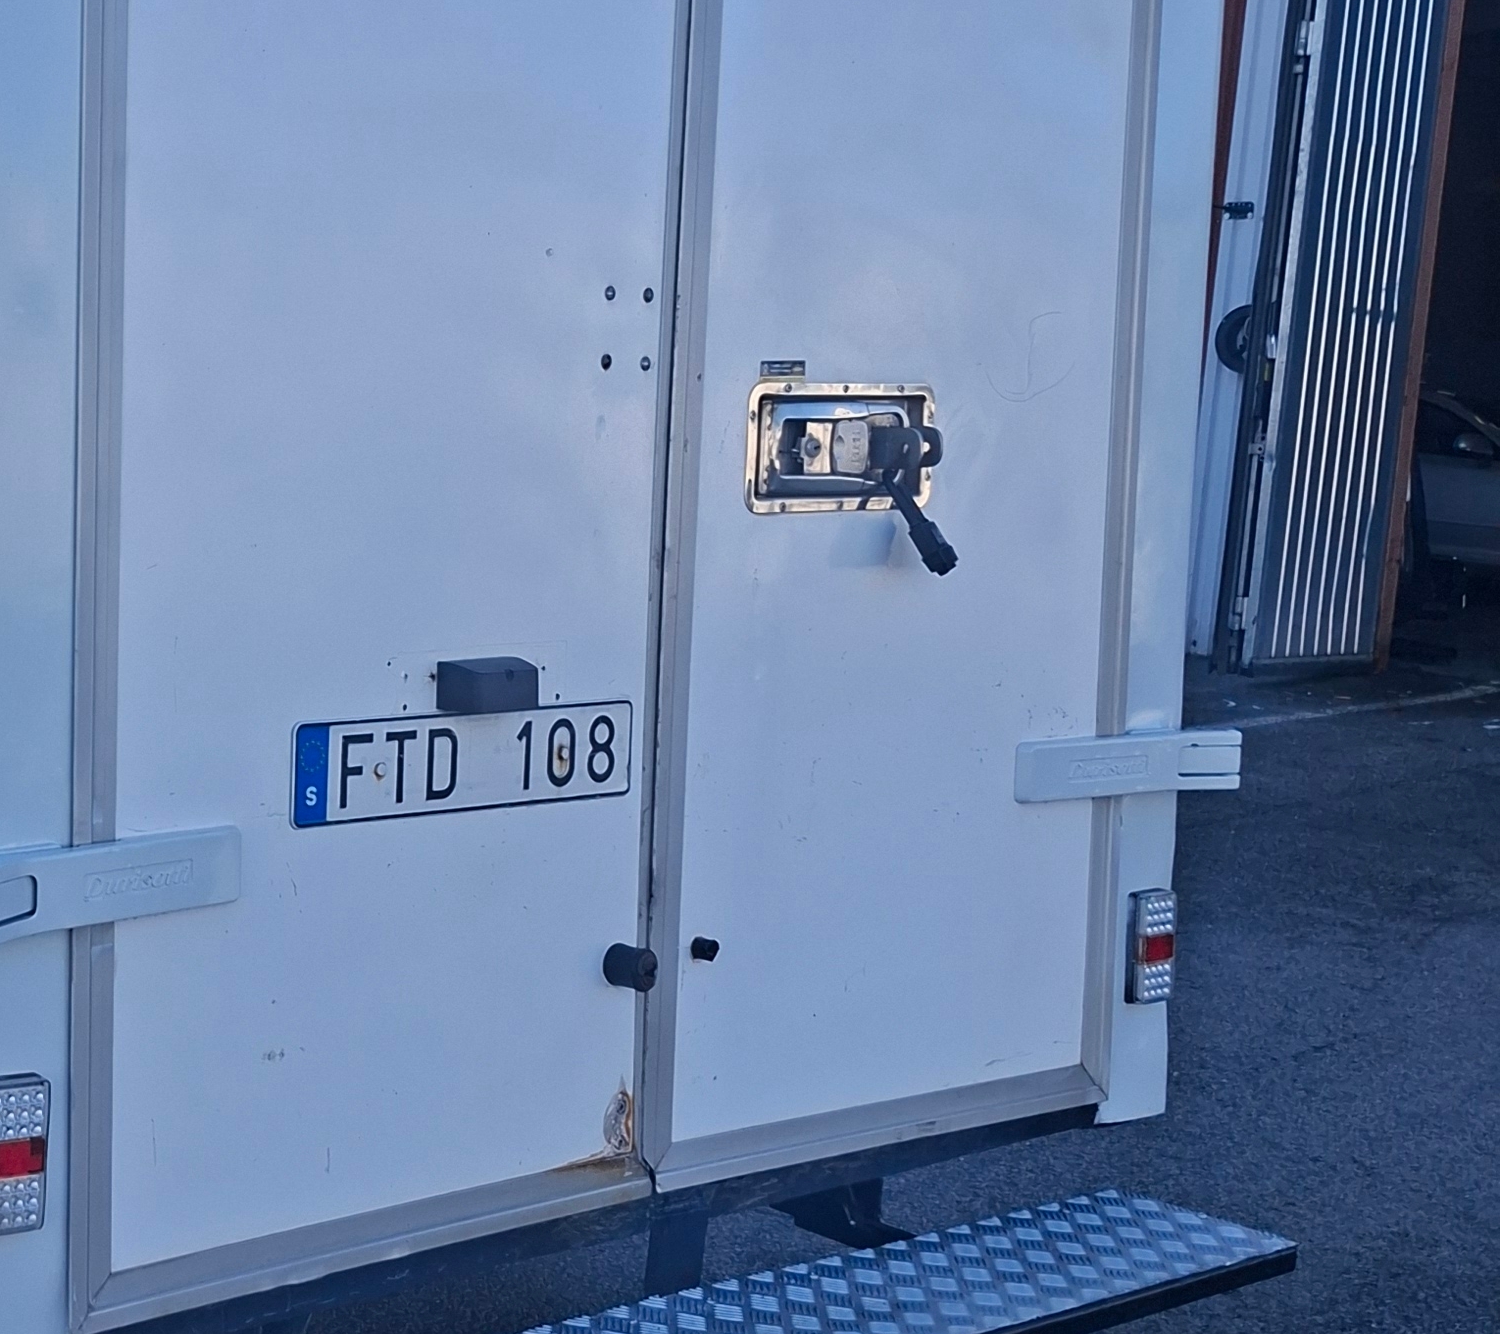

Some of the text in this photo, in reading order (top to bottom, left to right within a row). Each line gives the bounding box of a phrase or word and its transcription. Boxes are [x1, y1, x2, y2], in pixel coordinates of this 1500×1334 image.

[339, 715, 615, 809] FTD 108
[305, 786, 318, 806] S
